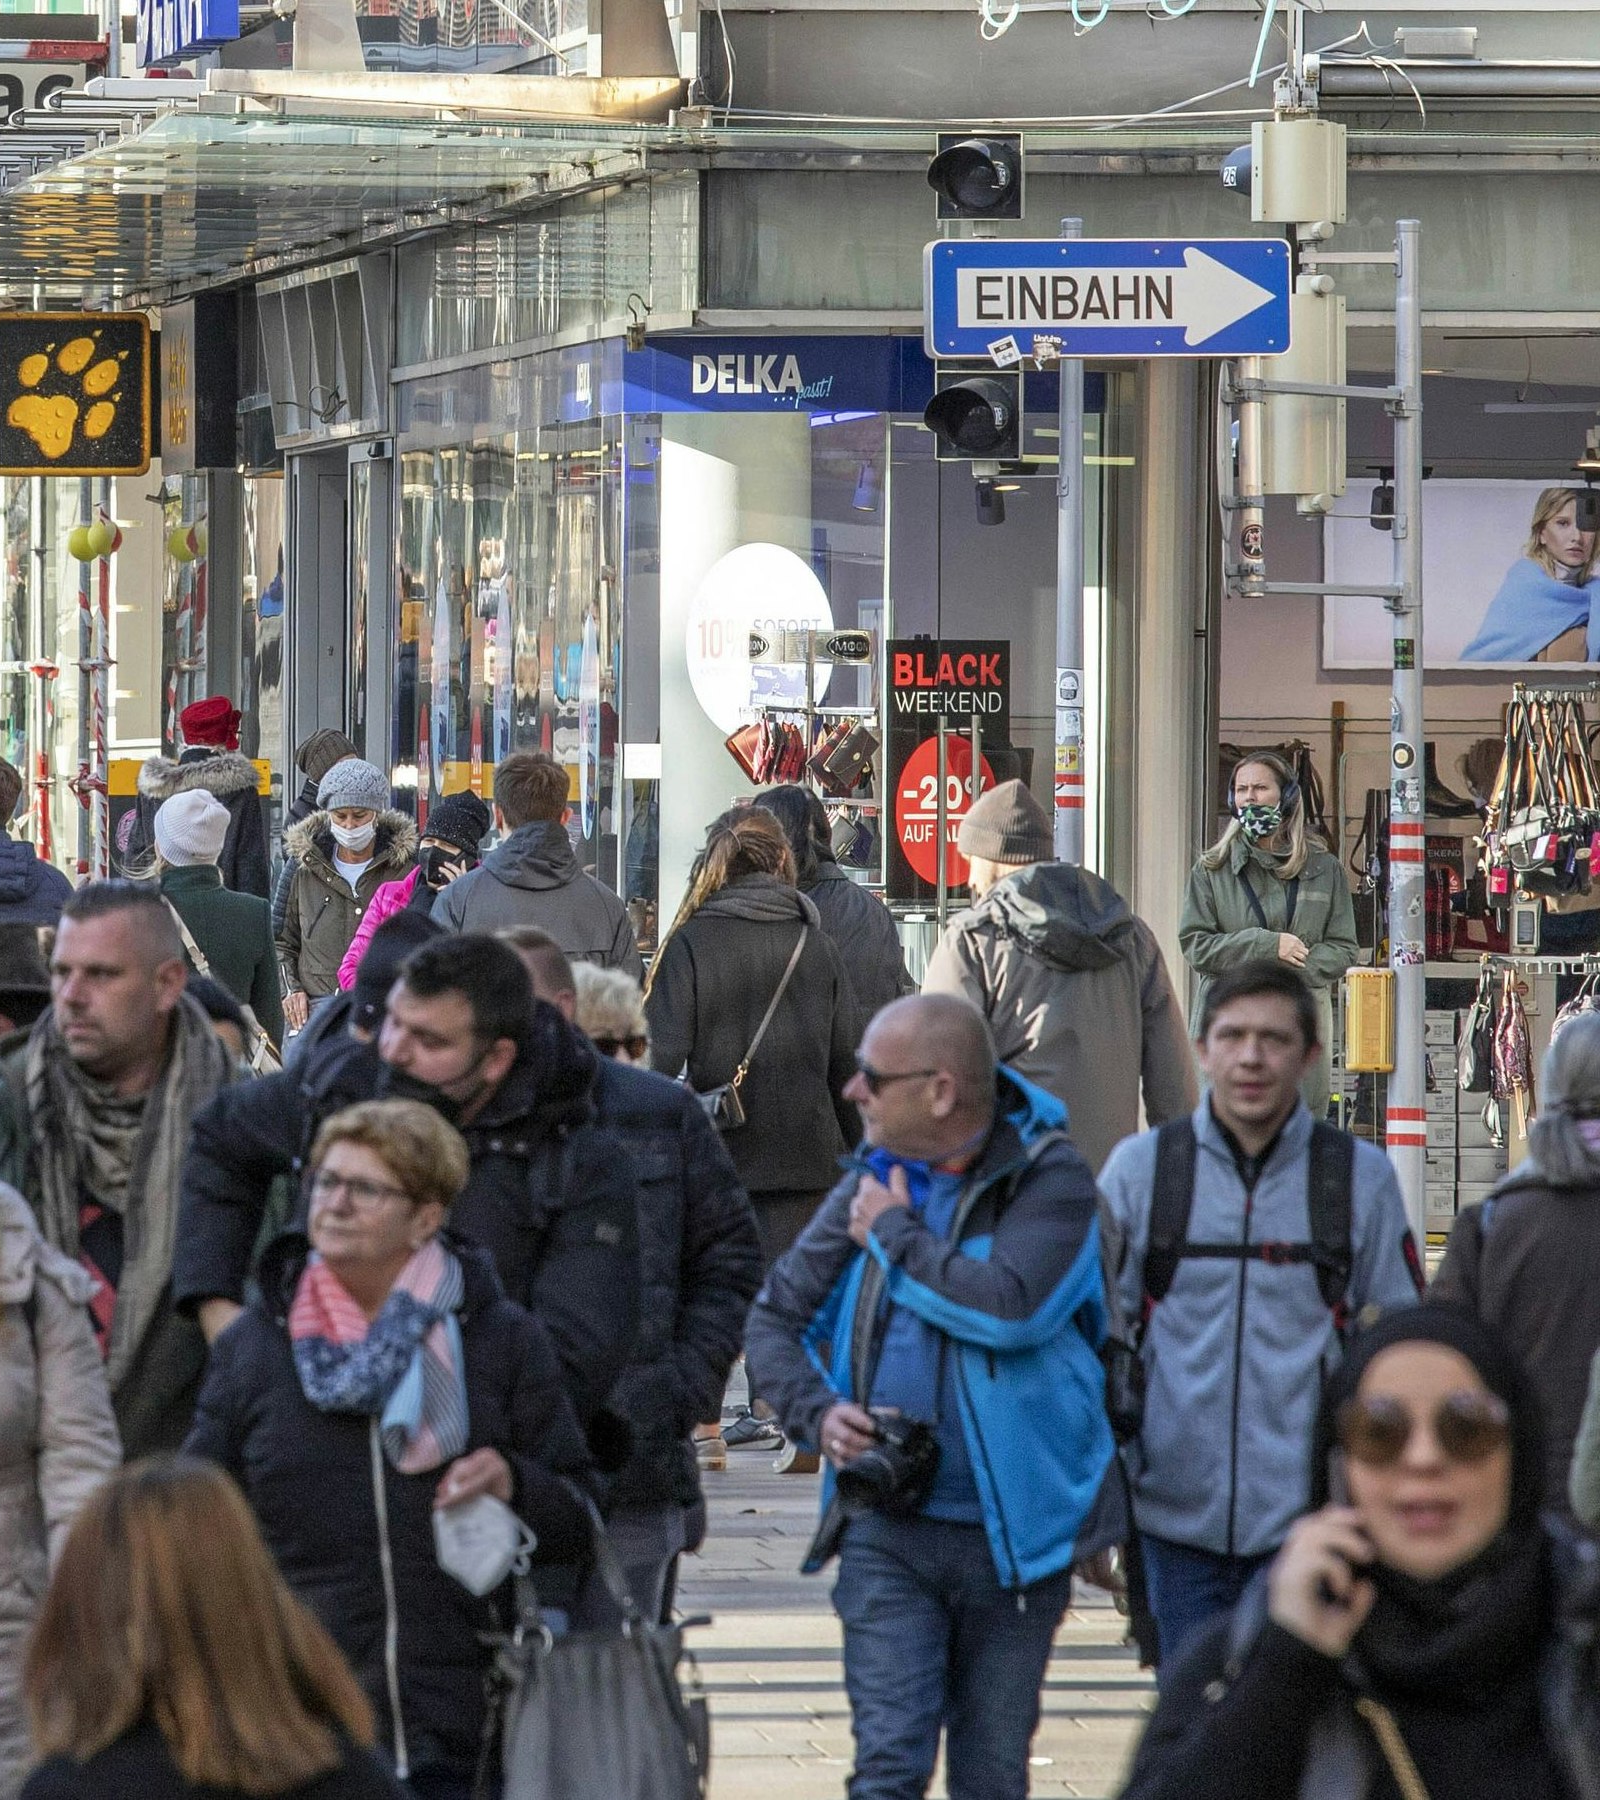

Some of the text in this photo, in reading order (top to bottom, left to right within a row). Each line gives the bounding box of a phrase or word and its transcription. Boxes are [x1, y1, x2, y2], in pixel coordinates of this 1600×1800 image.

[1224, 168, 1236, 185] 26
[976, 276, 1173, 320] EINBAHN
[693, 355, 803, 394] DELKA
[894, 653, 1002, 687] BLACK
[895, 691, 1003, 714] WEEKEND
[903, 823, 934, 843] AUF
[1427, 849, 1462, 858] EKEND
